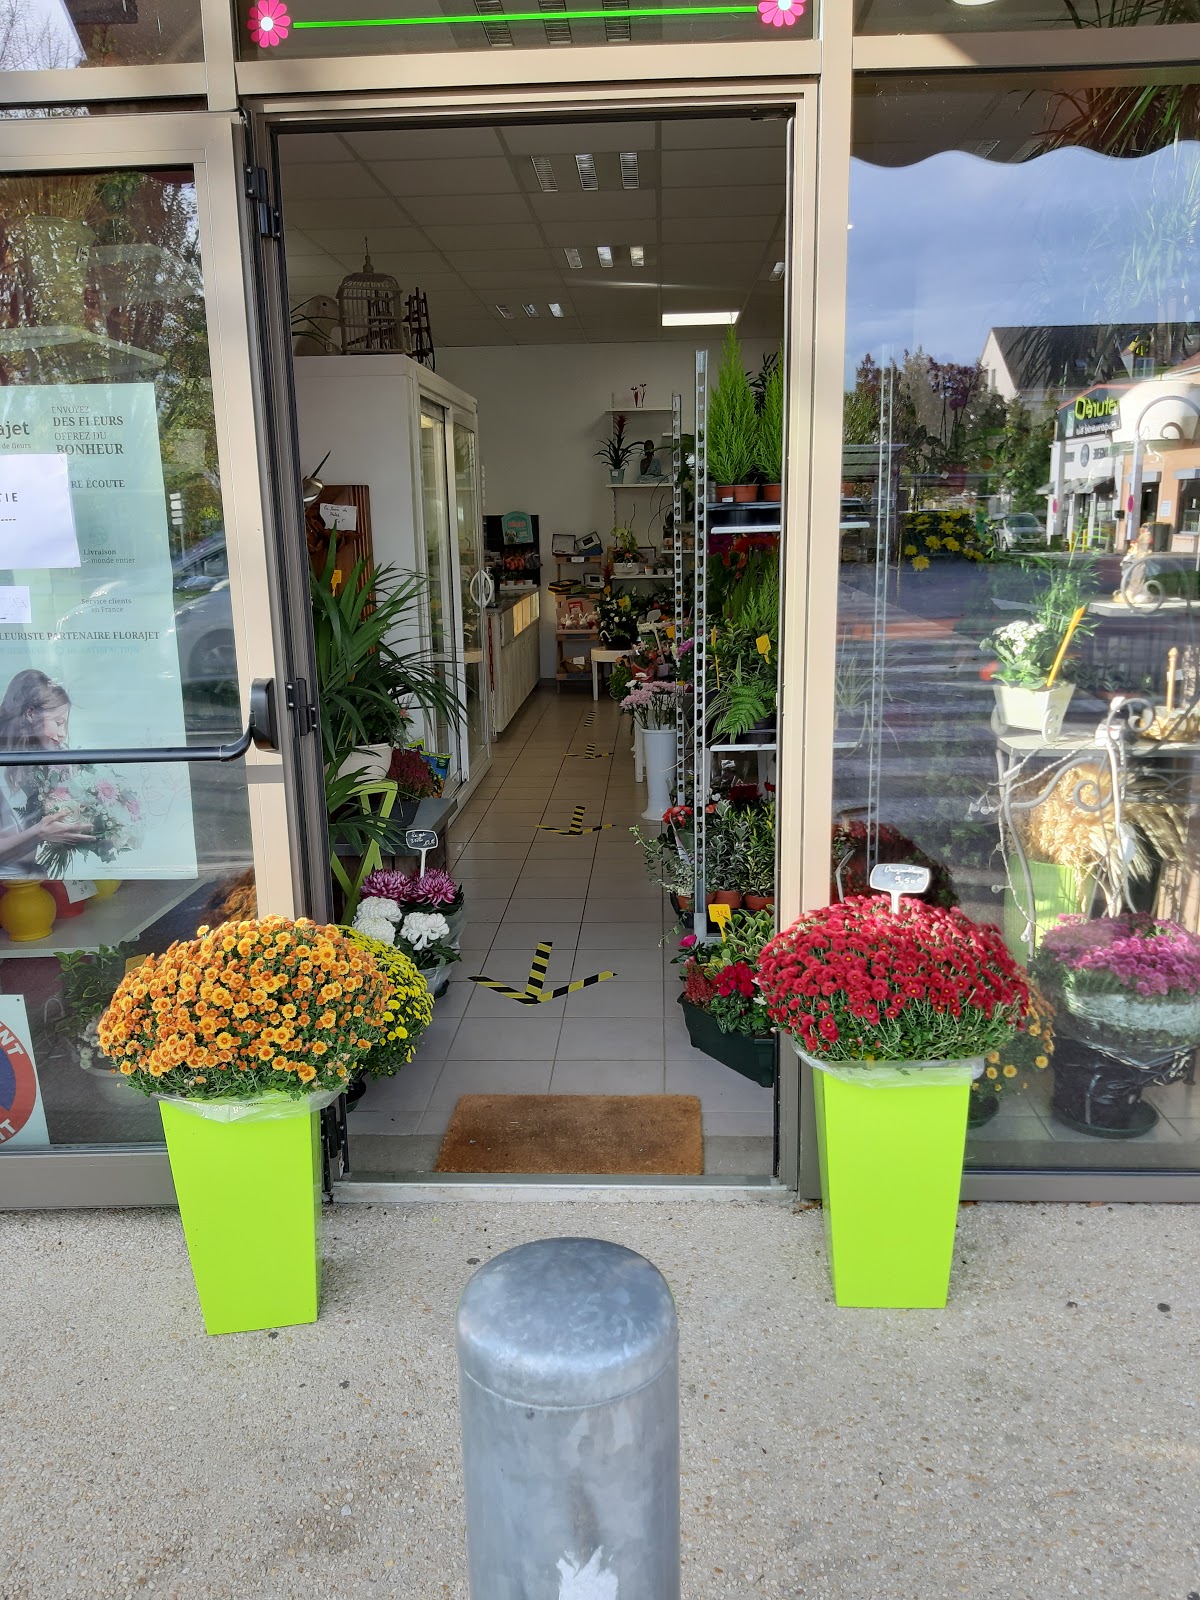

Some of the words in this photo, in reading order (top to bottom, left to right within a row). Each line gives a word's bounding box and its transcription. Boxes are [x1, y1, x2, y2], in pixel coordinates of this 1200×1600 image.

[51, 405, 90, 414] ENVOYEZ
[53, 416, 75, 426] DES
[78, 415, 124, 426] FLEURS
[0, 420, 30, 439] ajet
[54, 431, 91, 441] OFFREZ
[93, 431, 107, 440] DU
[56, 443, 125, 455] BONHEUR
[70, 480, 84, 488] RE
[86, 478, 126, 488] ÉCOUTE
[83, 548, 117, 556] Livraison
[108, 597, 132, 605] clients
[0, 632, 45, 640] LEURISTE
[47, 631, 111, 640] PARTENAIRE
[113, 631, 160, 641] FLORAJET
